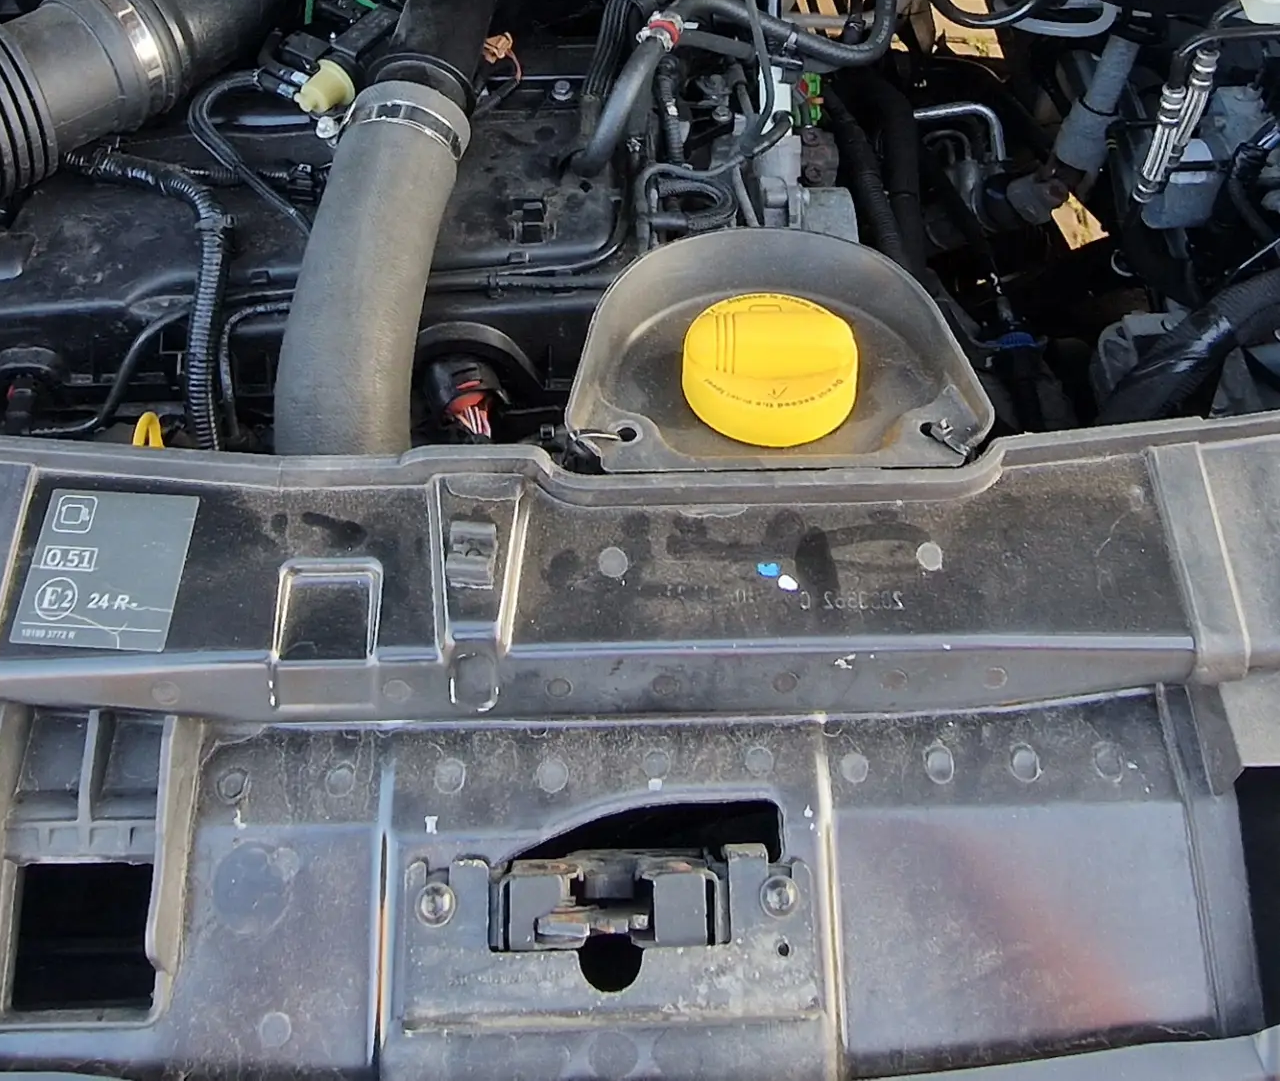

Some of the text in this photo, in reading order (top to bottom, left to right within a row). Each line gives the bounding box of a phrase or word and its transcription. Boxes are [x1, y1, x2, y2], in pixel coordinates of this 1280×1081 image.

[46, 548, 92, 569] 0,51
[41, 586, 74, 610] E2
[87, 593, 110, 610] 24
